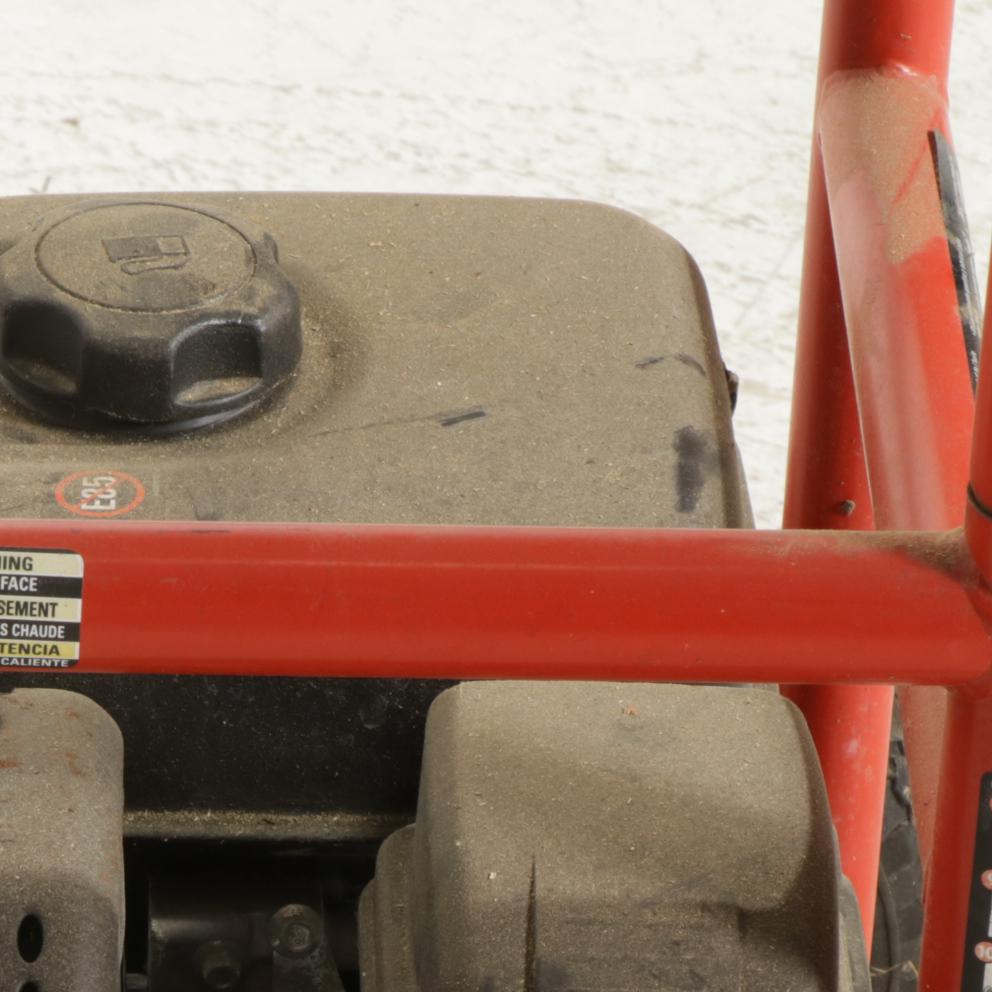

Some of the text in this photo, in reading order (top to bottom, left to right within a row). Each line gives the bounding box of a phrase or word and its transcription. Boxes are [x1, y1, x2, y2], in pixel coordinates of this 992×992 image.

[81, 475, 117, 512] E85
[11, 624, 65, 639] CHAUDE
[4, 657, 69, 668] CALIENTE
